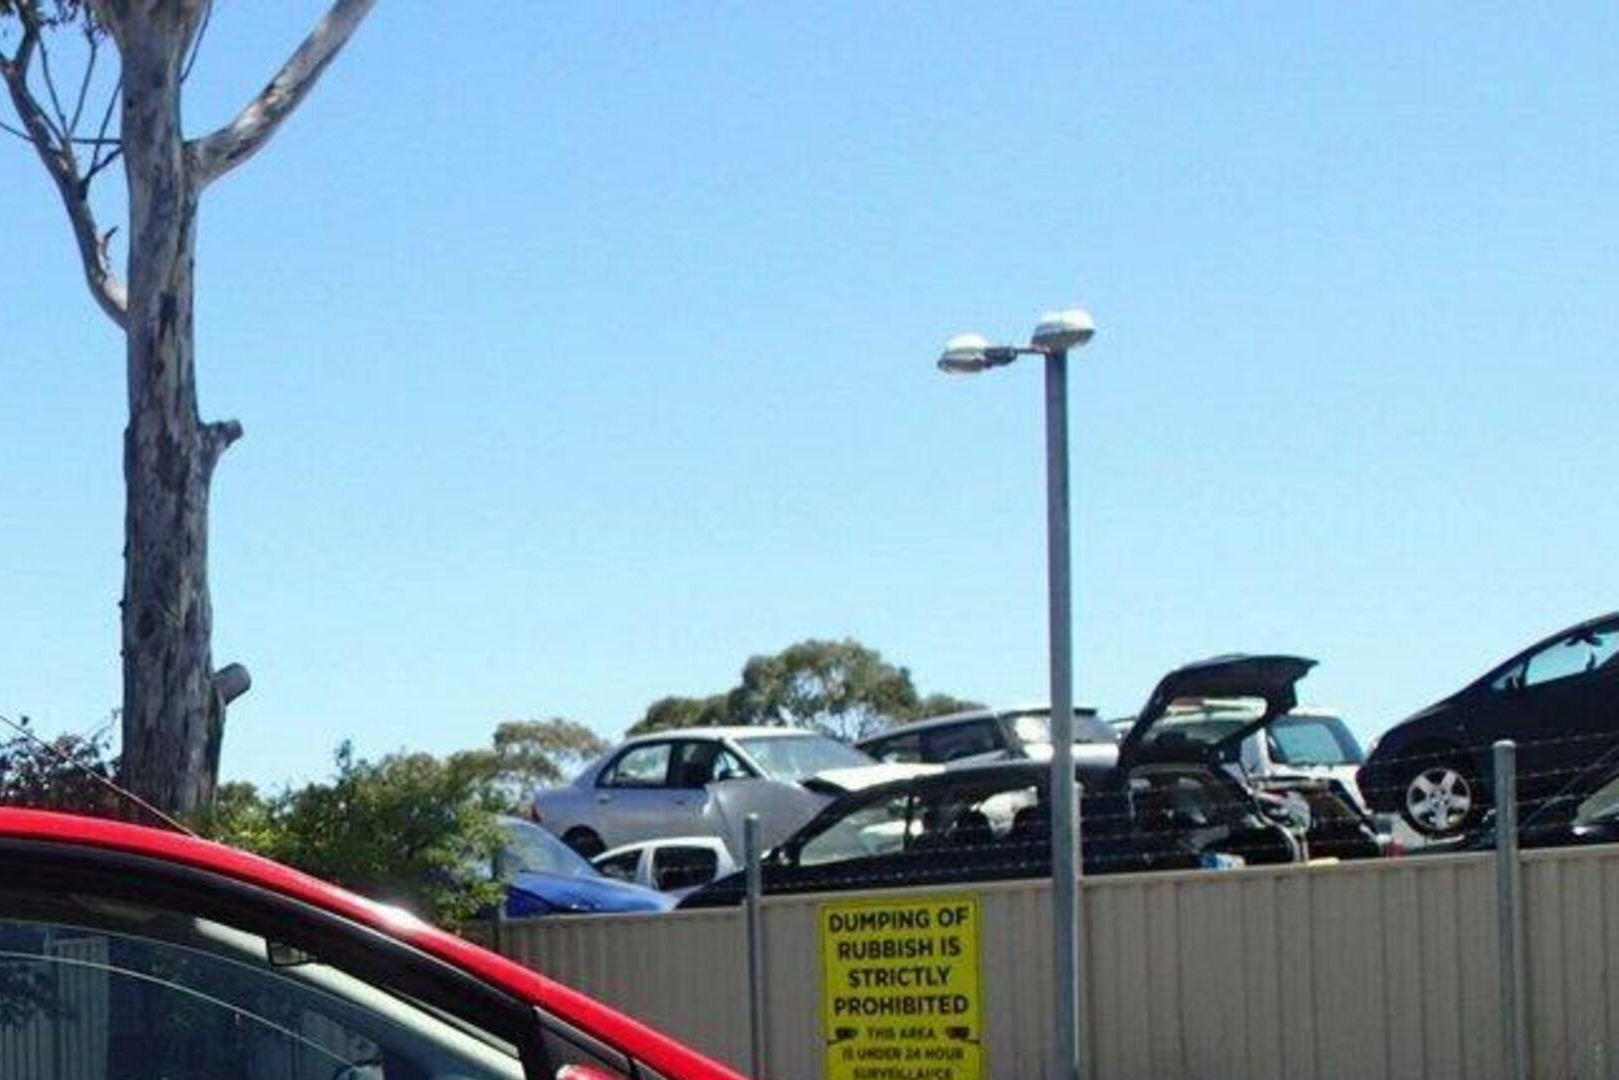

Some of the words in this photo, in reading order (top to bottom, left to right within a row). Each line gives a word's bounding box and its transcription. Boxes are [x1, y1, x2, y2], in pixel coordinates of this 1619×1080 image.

[829, 909, 930, 933] DUMPING
[938, 907, 970, 928] OF
[838, 939, 933, 961] RUBBISH
[941, 936, 962, 957] IS
[848, 966, 952, 988] STRICTLY
[834, 995, 969, 1017] PROHIBITED
[867, 1026, 896, 1040] THIS
[900, 1026, 936, 1040] AREA
[842, 1048, 853, 1061] IS
[857, 1047, 902, 1061] UNDER
[905, 1047, 921, 1061] 24
[924, 1047, 964, 1060] HOUR
[853, 1067, 954, 1080] SURVEILLANCE
